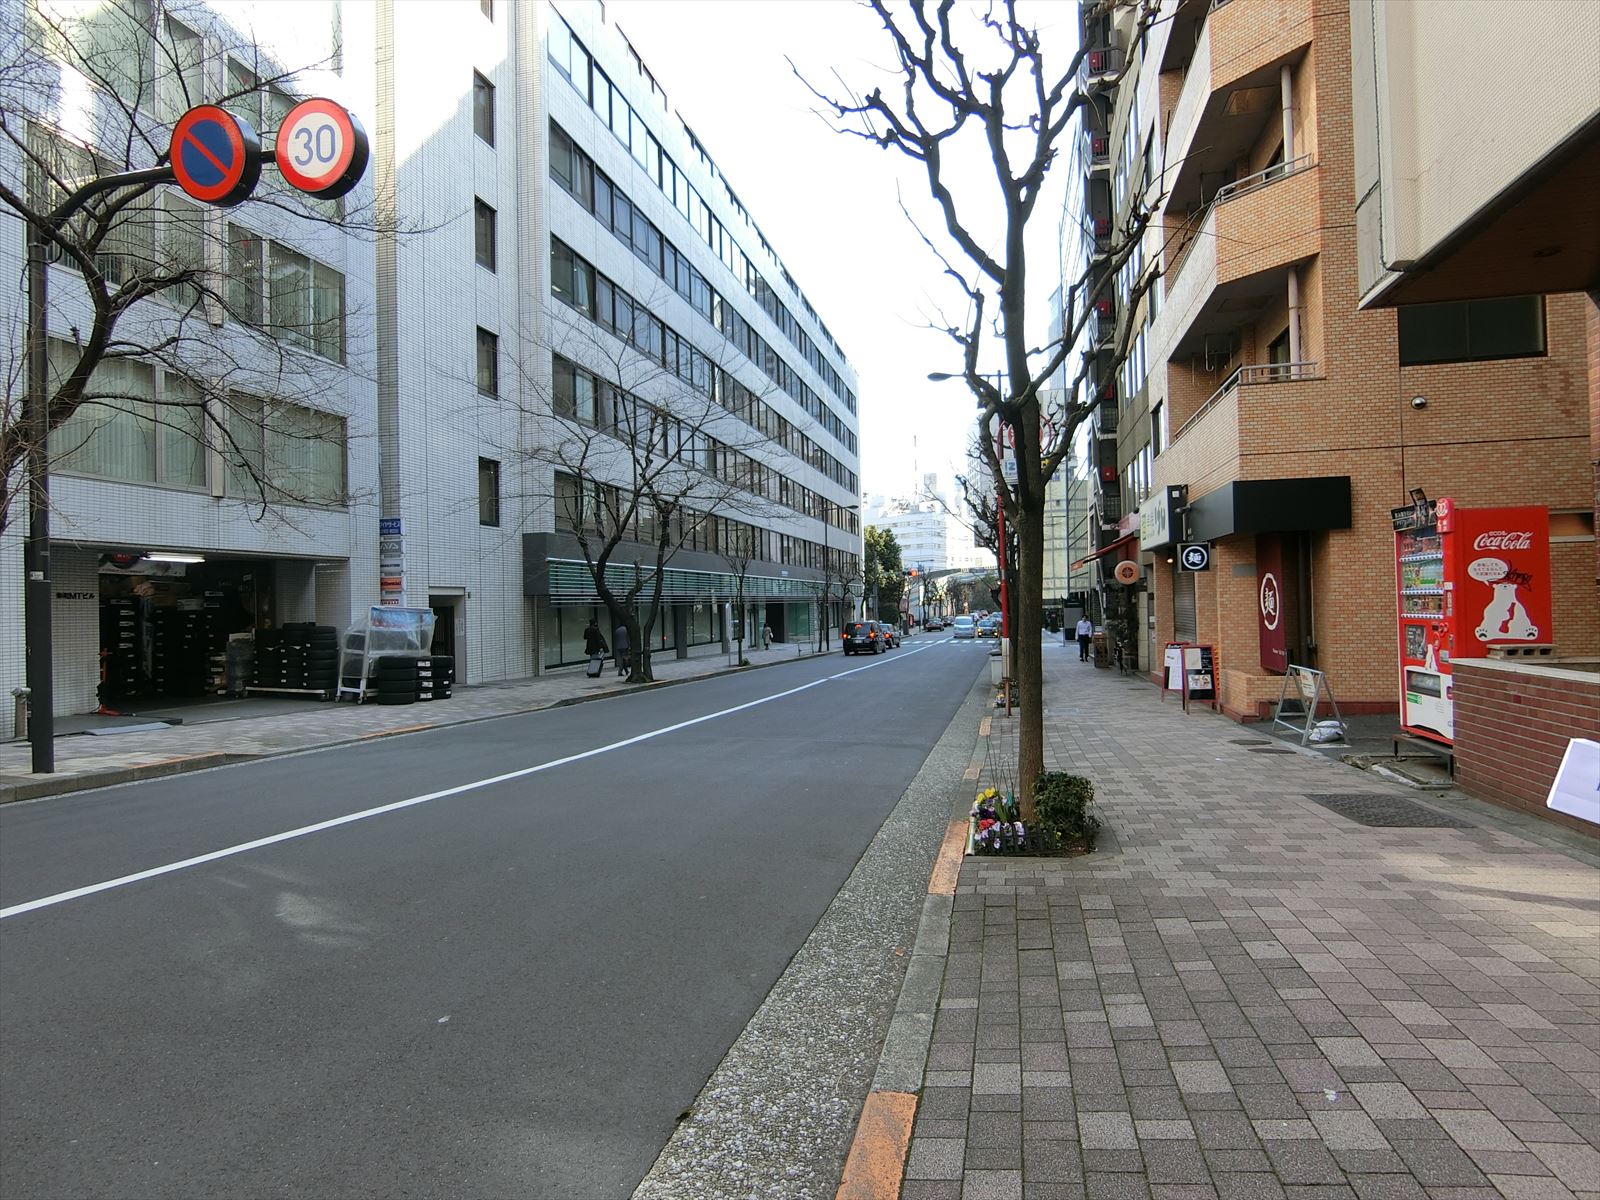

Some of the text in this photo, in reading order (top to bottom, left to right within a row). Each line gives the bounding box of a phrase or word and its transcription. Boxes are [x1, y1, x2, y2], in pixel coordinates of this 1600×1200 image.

[294, 124, 336, 166] 30
[1187, 551, 1202, 564] 麺
[1264, 587, 1276, 616] 麺
